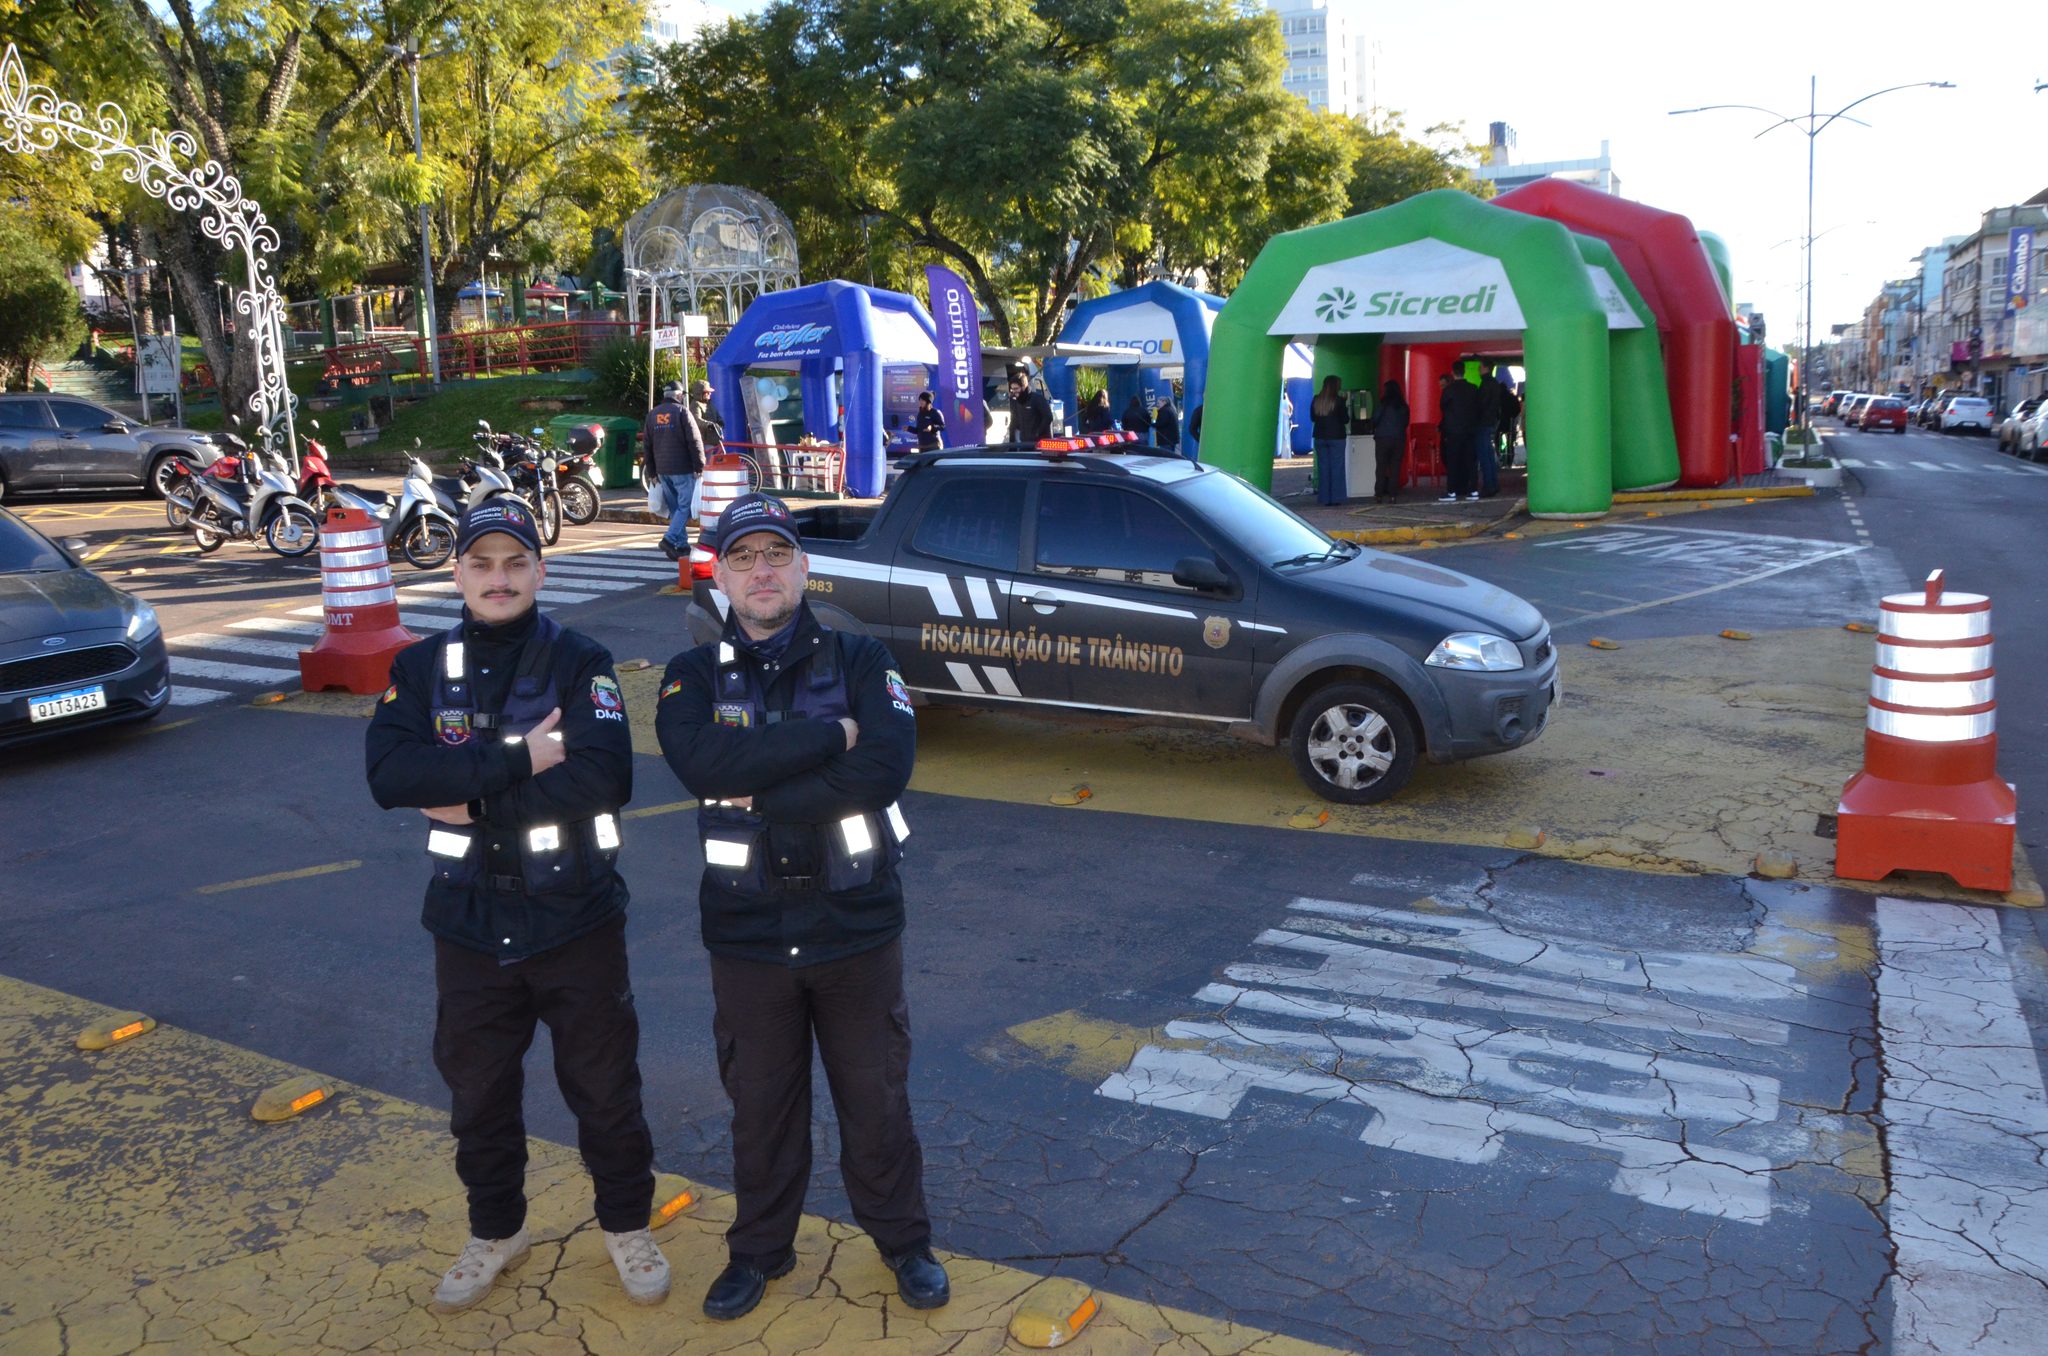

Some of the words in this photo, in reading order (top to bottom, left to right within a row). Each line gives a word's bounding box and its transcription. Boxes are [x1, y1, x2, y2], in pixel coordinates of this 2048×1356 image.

[2011, 233, 2029, 294] Colombo
[1363, 284, 1498, 317] Sicredi
[657, 329, 677, 339] TAXI
[921, 623, 1052, 666] FISCALIZAÇÃO
[1057, 635, 1081, 665] DE
[1087, 633, 1183, 677] TRÂNSITO
[38, 694, 98, 717] QIT3A23
[595, 709, 623, 722] DMT
